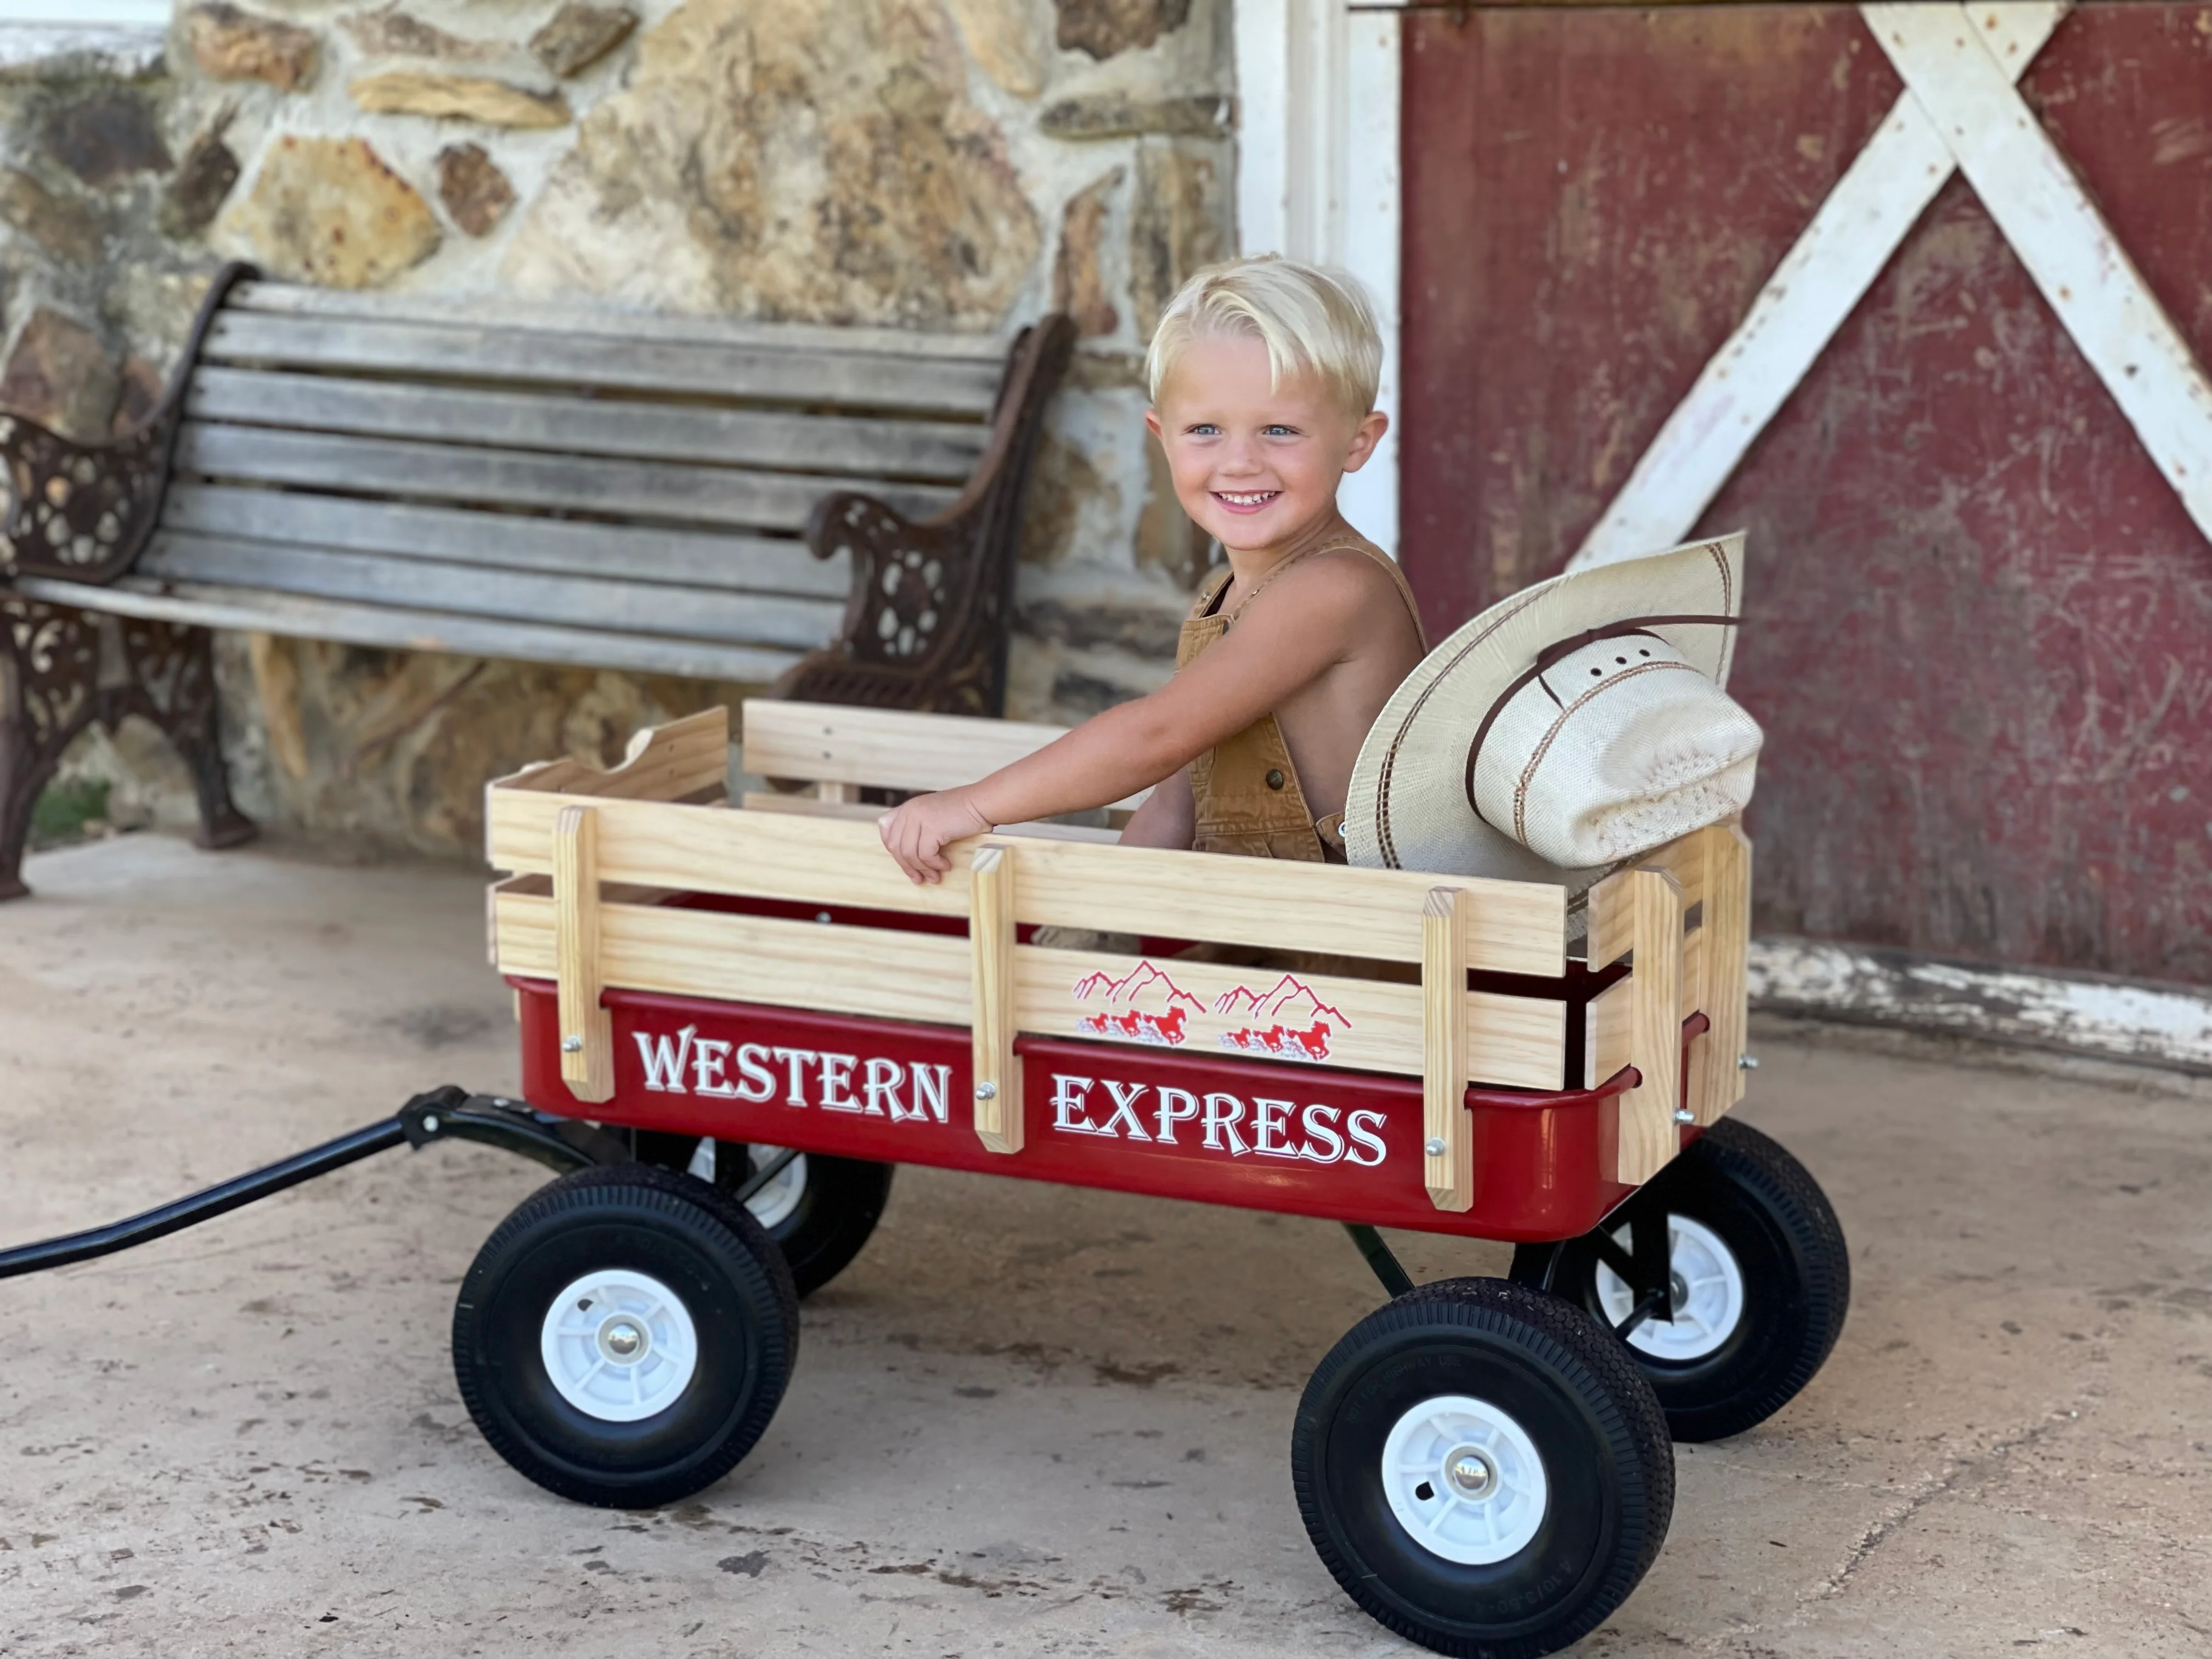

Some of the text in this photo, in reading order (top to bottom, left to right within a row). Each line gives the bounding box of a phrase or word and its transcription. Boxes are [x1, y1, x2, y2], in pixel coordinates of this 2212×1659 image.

[632, 1024, 1387, 1166] WESTERN EXPRESS
[1383, 1357, 1432, 1382] HIGHWAY
[1438, 1355, 1462, 1367] USE
